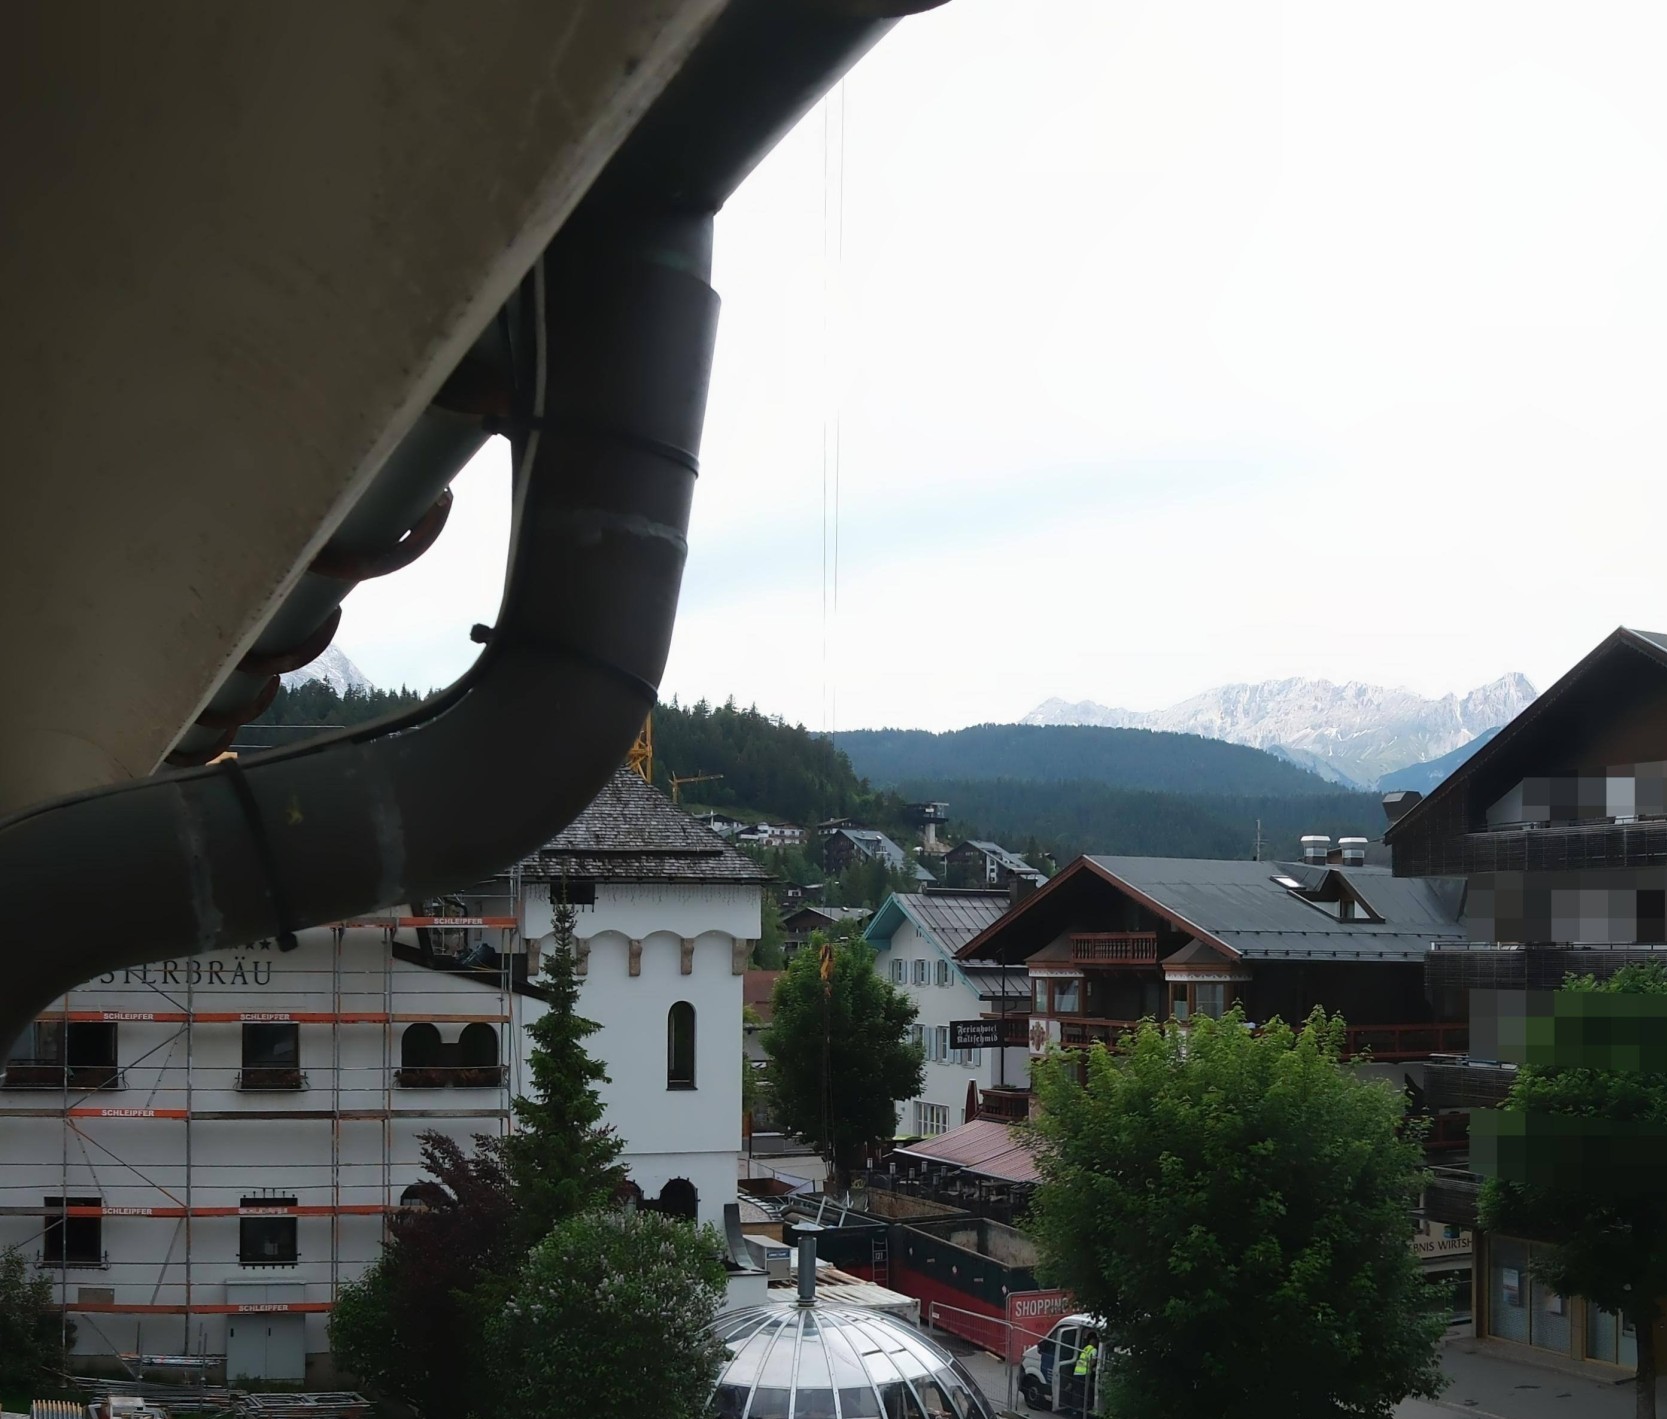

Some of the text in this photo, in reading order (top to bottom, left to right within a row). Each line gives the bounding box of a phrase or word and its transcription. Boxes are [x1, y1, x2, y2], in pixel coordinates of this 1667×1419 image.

[102, 1109, 155, 1117] SCHLEIPFER
[102, 1206, 153, 1215] SCHLEIPFER
[239, 1304, 289, 1312] SCHLEIPFER
